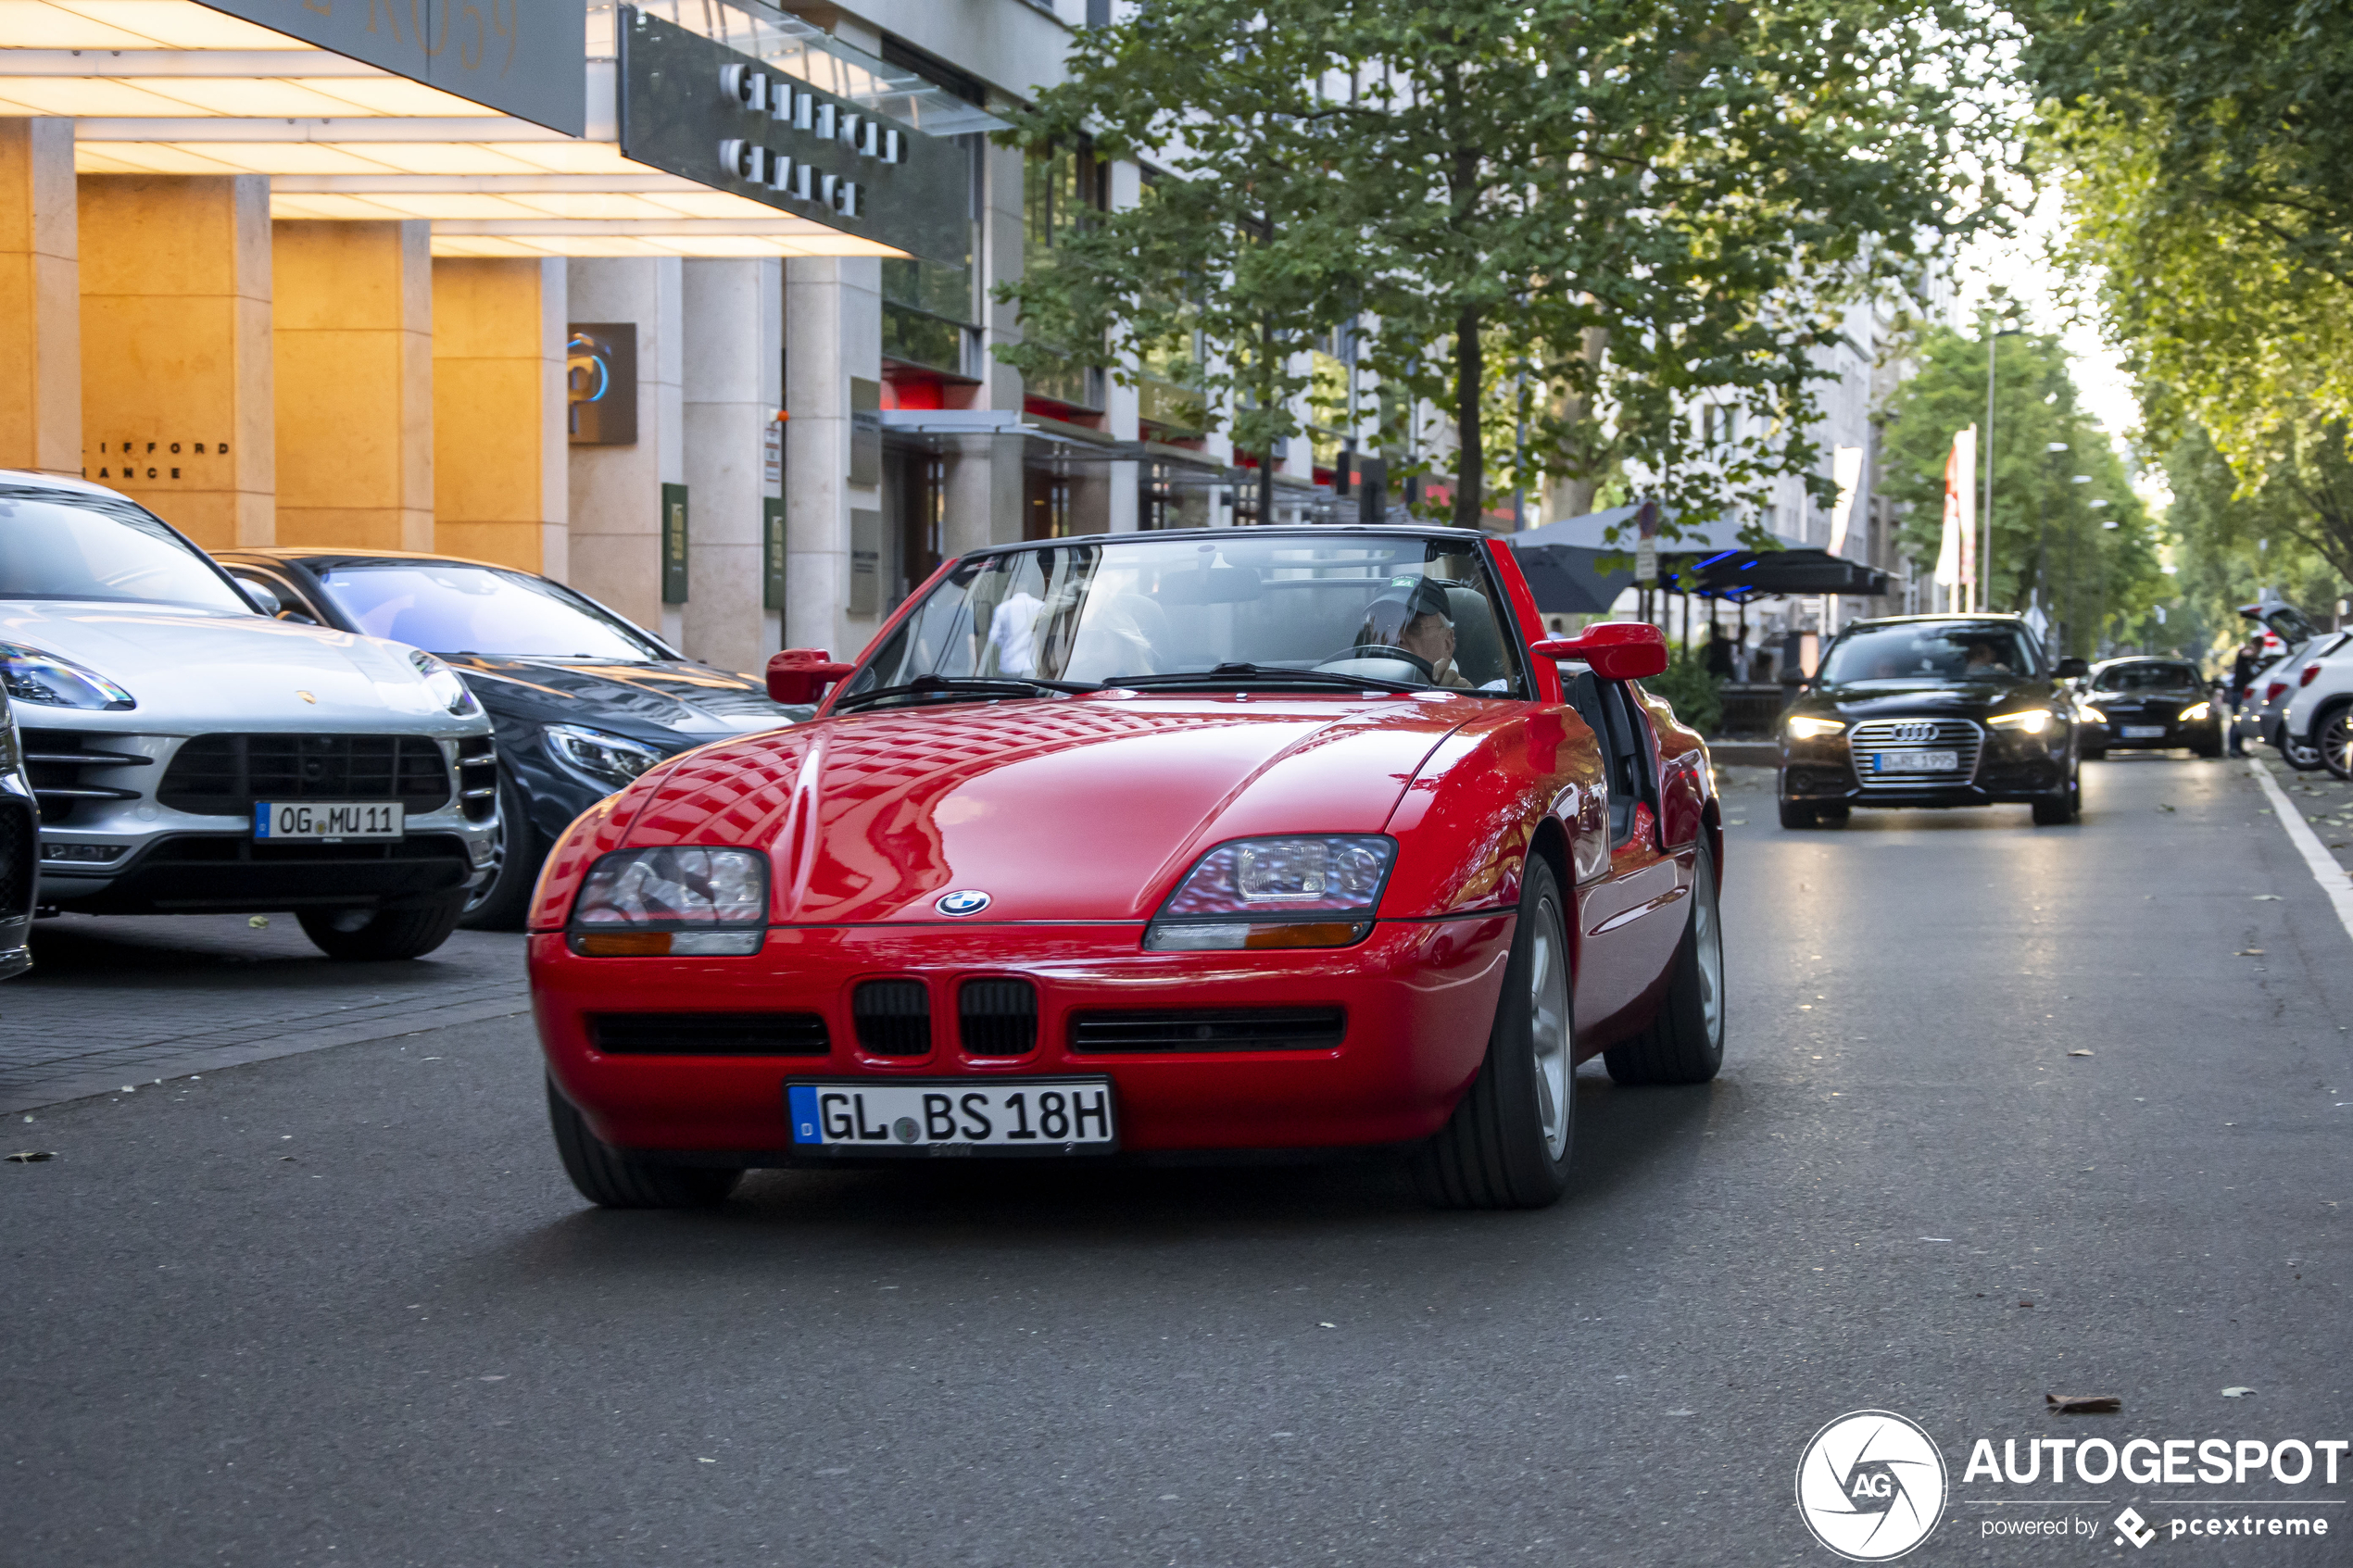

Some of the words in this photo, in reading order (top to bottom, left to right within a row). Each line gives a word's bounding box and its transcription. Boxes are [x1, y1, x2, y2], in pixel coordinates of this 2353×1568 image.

[82, 442, 229, 455] IFFORD
[280, 807, 312, 834] OG
[329, 807, 361, 834] MU
[366, 807, 393, 834] 11
[820, 1092, 888, 1140] GL
[923, 1092, 993, 1140] BS
[1005, 1090, 1109, 1139] 18H
